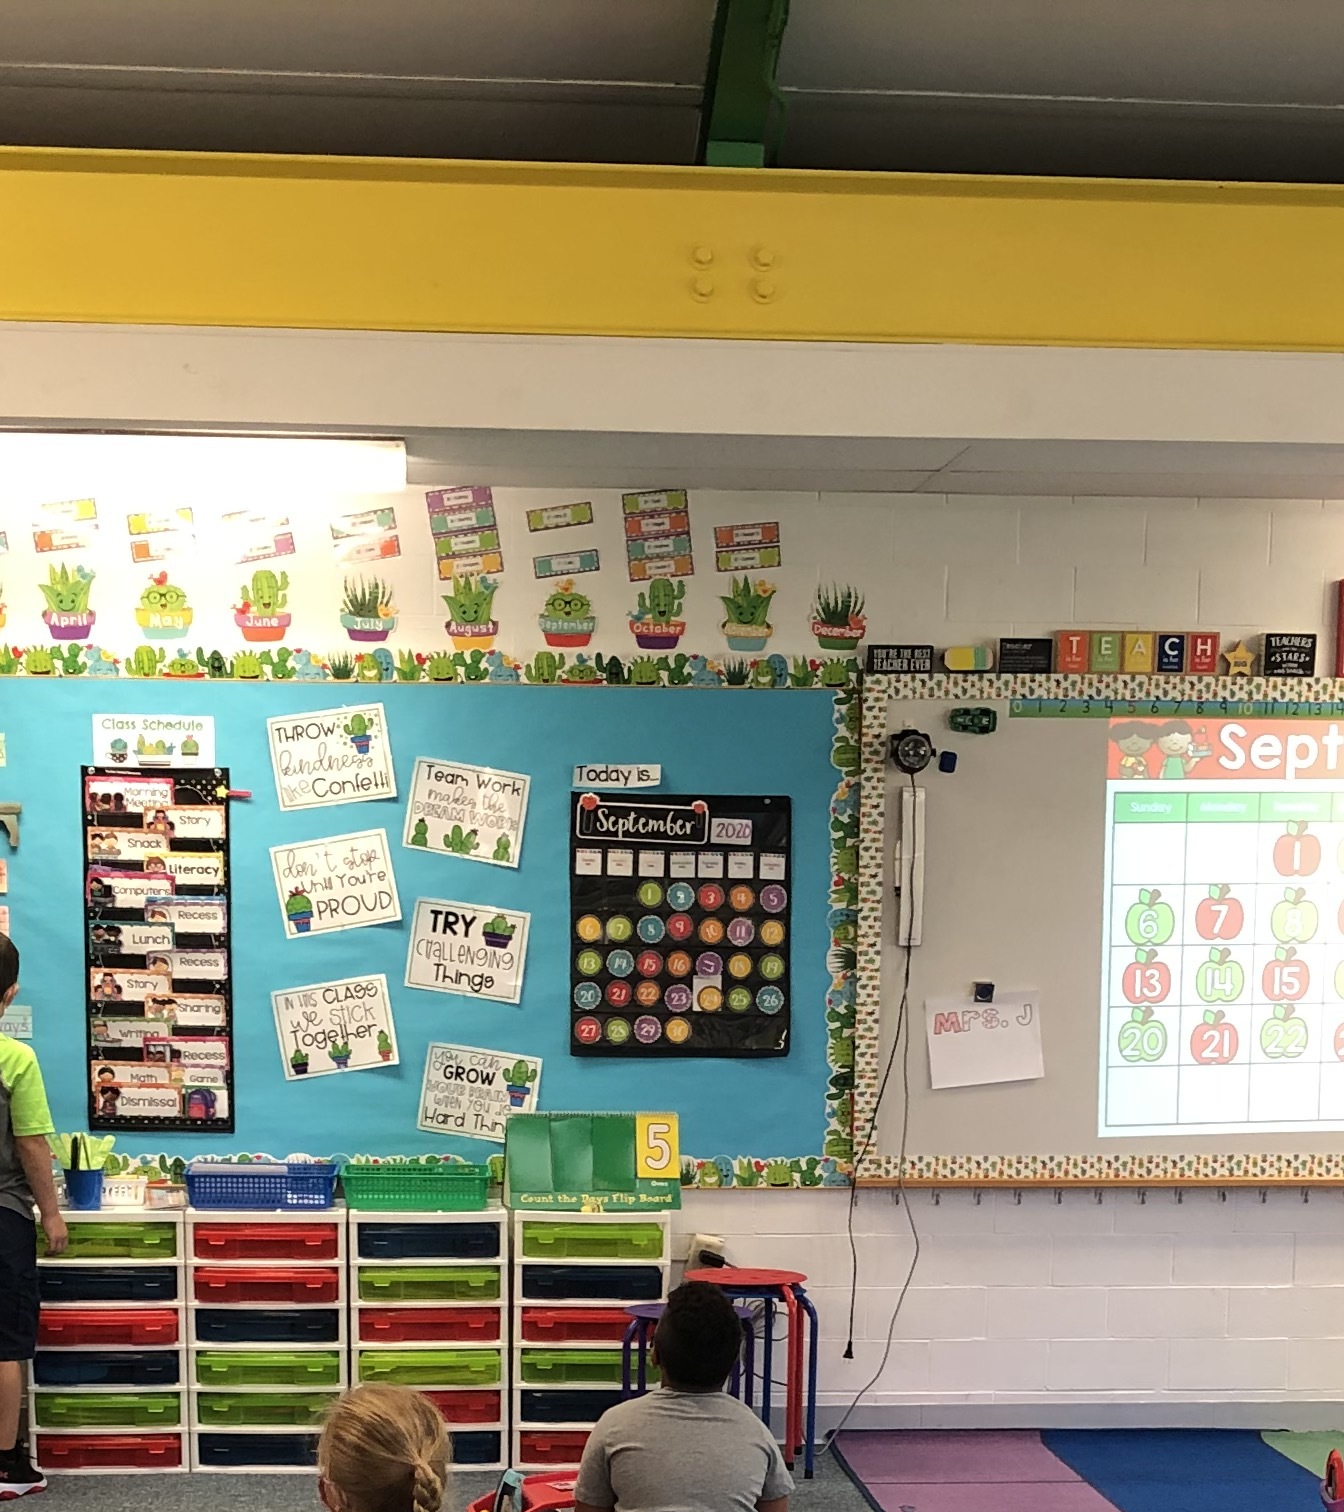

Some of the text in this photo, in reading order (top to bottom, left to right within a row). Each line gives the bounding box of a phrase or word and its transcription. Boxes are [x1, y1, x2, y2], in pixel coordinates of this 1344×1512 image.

[49, 612, 89, 629] April
[149, 613, 185, 632] May
[244, 613, 279, 629] June
[352, 614, 392, 632] July
[632, 620, 684, 636] October
[448, 621, 495, 639] August
[812, 622, 866, 640] December
[1068, 636, 1081, 655] T
[1101, 636, 1113, 655] E
[1131, 637, 1146, 655] A
[1164, 637, 1180, 656] C
[1197, 637, 1212, 656] H
[1269, 636, 1314, 648] TEACHERS
[101, 718, 204, 731] Class Schedule
[274, 721, 337, 744] THROW
[279, 742, 374, 777] kindness
[311, 770, 390, 798] Confetti
[426, 764, 522, 797] Team Work
[575, 765, 632, 786] Today
[124, 787, 169, 799] Morning
[427, 786, 507, 814] makes the
[413, 801, 519, 832] DREAM WORK
[1129, 801, 1172, 816] Sunday
[179, 815, 211, 827] Story
[596, 808, 752, 840] September 2020
[127, 838, 162, 849] Snack
[342, 846, 381, 871] stop
[169, 863, 220, 877] Literacy
[112, 885, 171, 896] Computers
[705, 892, 716, 904] 3
[315, 890, 393, 921] PROUD
[178, 910, 218, 921] Recess
[429, 908, 477, 939] TRY
[1210, 904, 1230, 935] 7
[676, 920, 685, 932] 9
[132, 933, 171, 945] Lunch
[179, 956, 220, 967] Recess
[126, 979, 158, 991] Story
[433, 962, 495, 993] Things
[1133, 967, 1163, 998] 13
[1273, 966, 1301, 996] 15
[322, 982, 379, 1004] CLASS
[612, 987, 627, 1000] 21
[178, 1002, 221, 1015] Sharing
[933, 1003, 1034, 1035] Mrs. J
[289, 1023, 378, 1050] Together
[581, 1024, 596, 1037] 27
[1201, 1028, 1231, 1060] 21
[183, 1049, 226, 1061] Recess
[130, 1072, 158, 1083] Math
[189, 1074, 219, 1084] Game
[442, 1064, 497, 1086] GROW
[120, 1096, 178, 1108] Dismissal
[424, 1105, 505, 1134] Hard Thin
[644, 1122, 672, 1171] 5
[520, 1193, 673, 1206] Count the Days Flip Board
